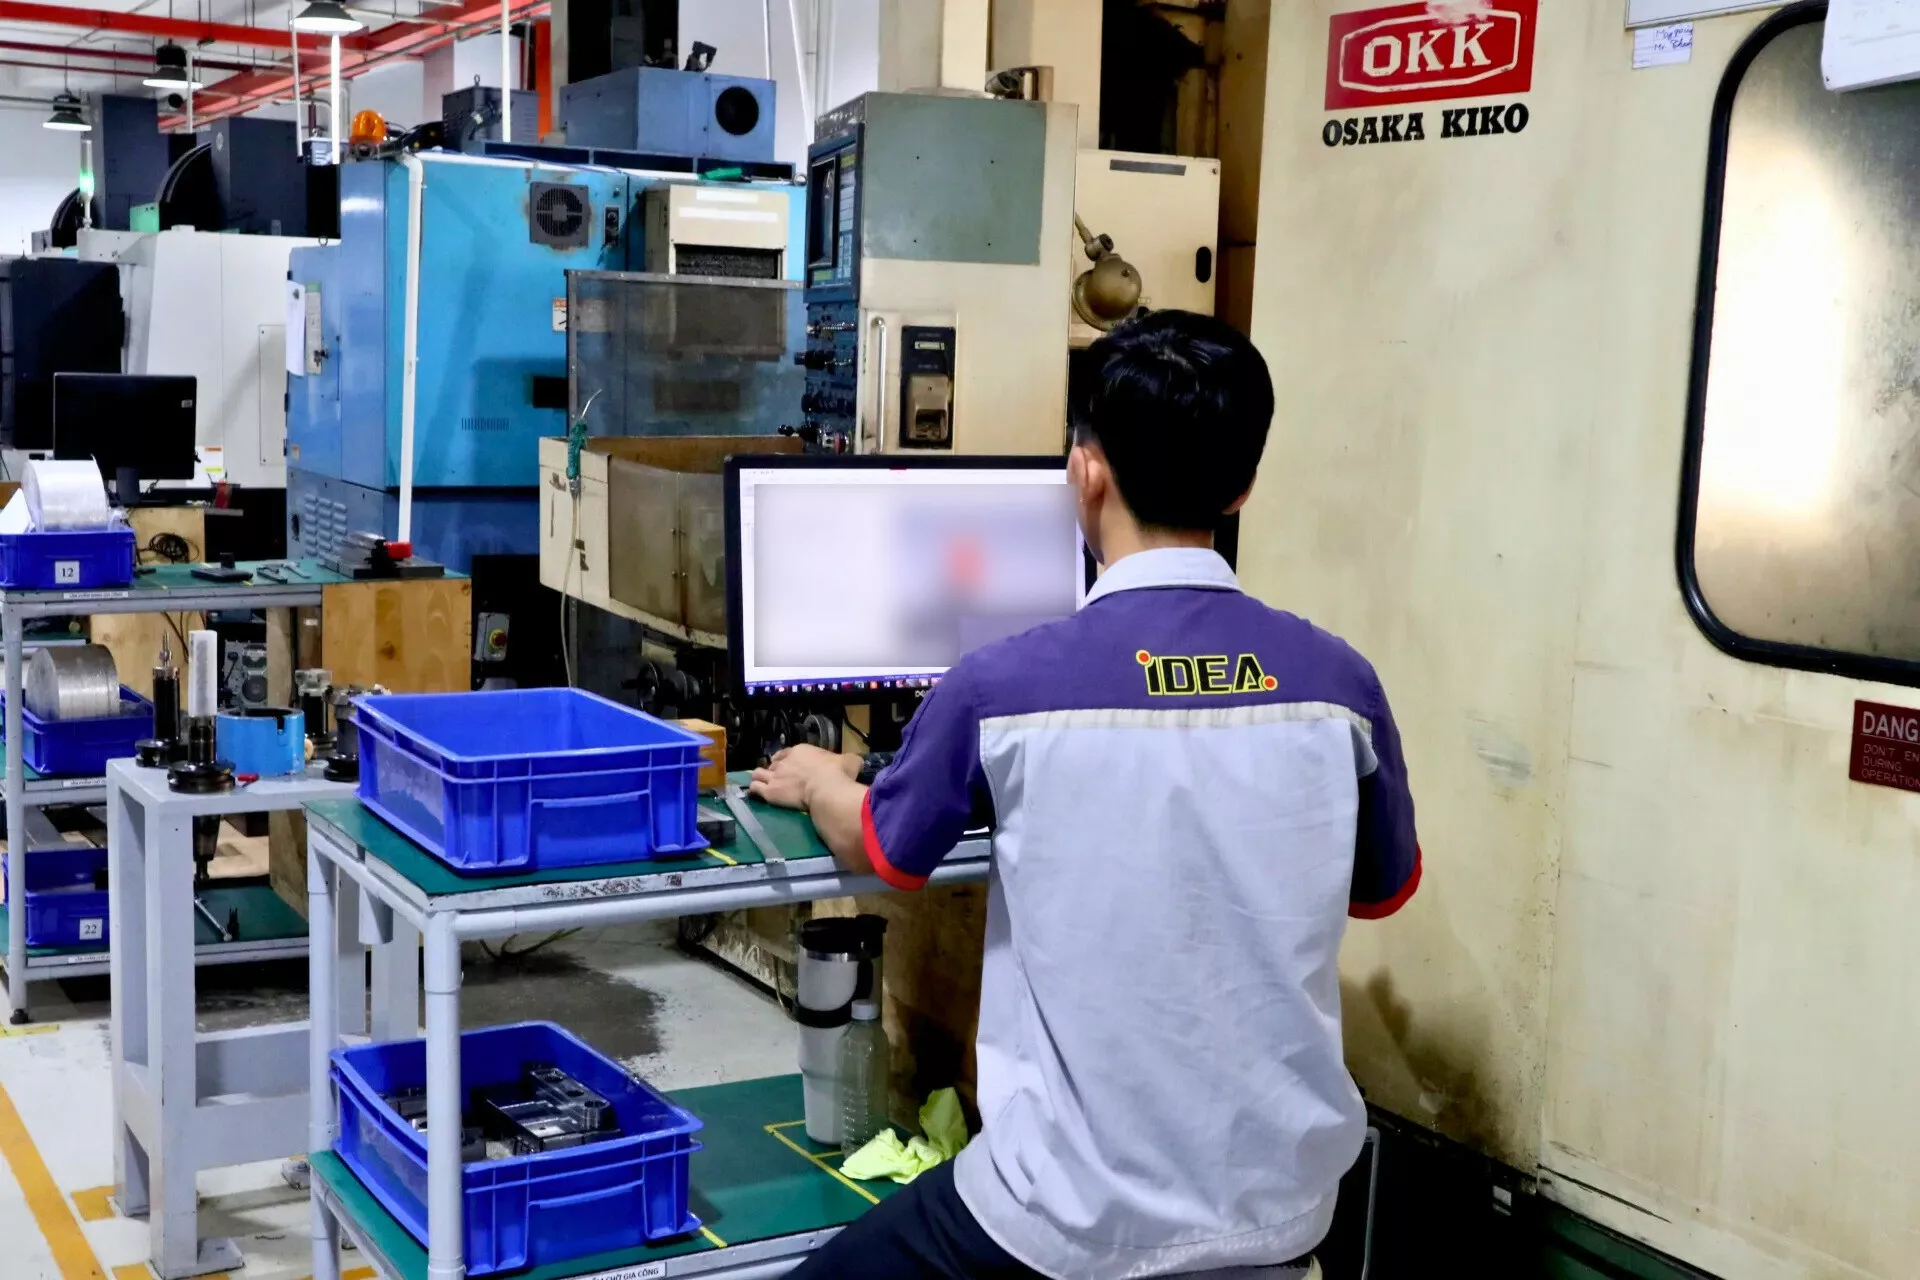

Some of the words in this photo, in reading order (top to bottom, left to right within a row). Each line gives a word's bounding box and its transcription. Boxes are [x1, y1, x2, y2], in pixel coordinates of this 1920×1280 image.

[1362, 22, 1494, 77] OKK
[1322, 112, 1424, 147] OSAKA
[1440, 103, 1529, 138] KIKO
[62, 568, 74, 578] 12
[1862, 711, 1919, 742] DANG
[1863, 743, 1896, 758] DON'T
[1863, 756, 1903, 772] DURING
[84, 924, 97, 935] 22
